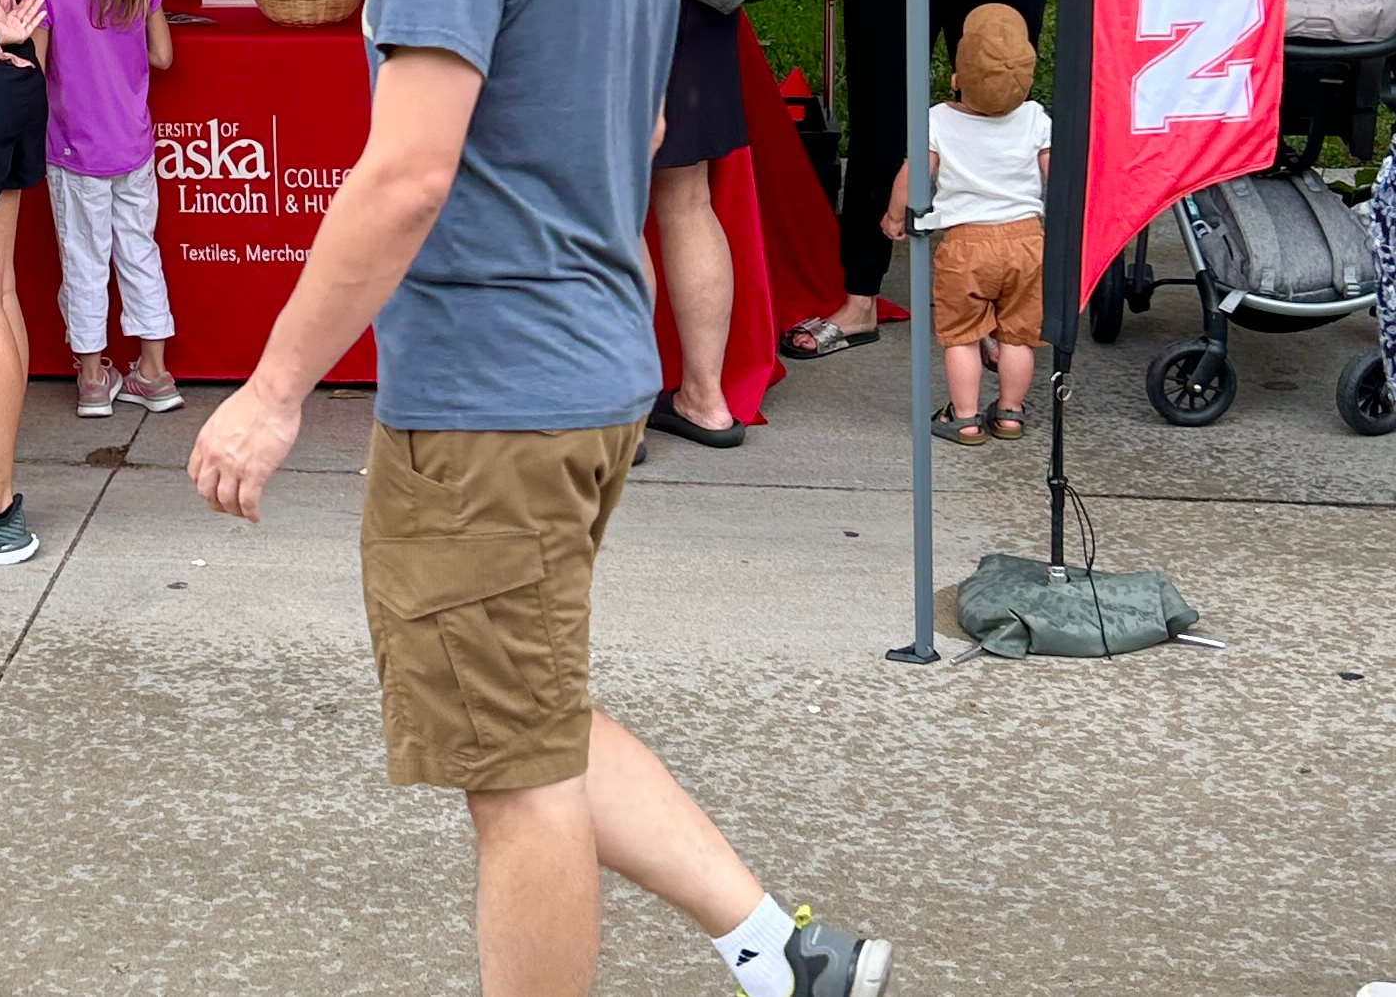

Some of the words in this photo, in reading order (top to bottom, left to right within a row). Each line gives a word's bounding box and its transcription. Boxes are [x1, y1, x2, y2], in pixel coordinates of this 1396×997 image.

[220, 122, 240, 138] OF
[177, 183, 269, 214] Lincoln
[285, 194, 300, 214] &
[180, 243, 241, 265] Textiles,
